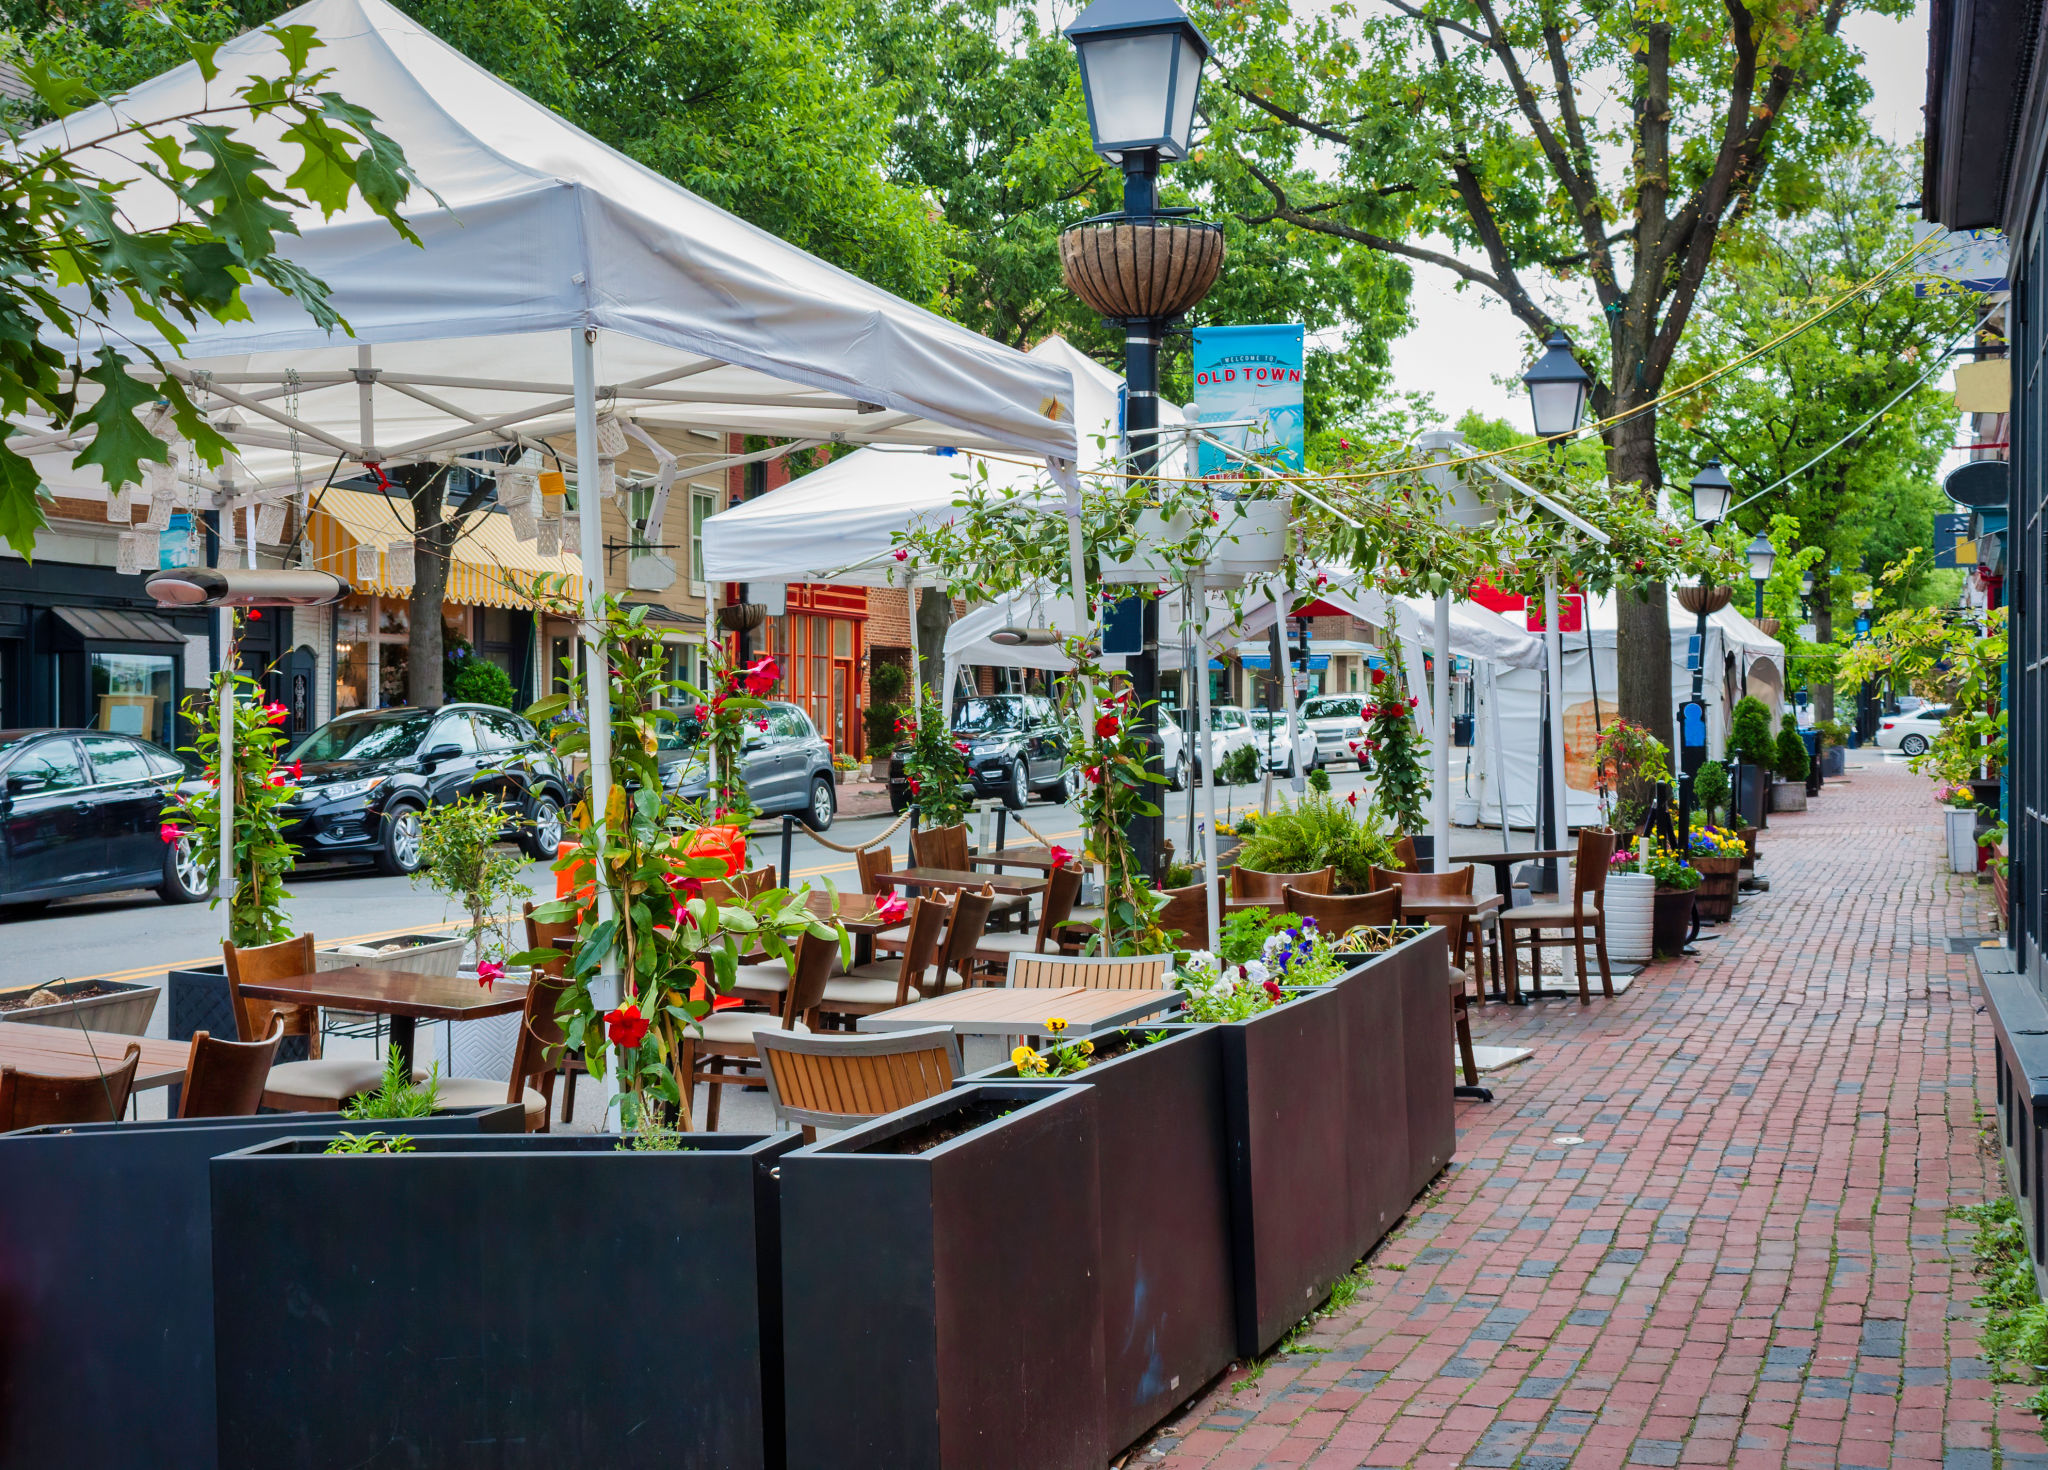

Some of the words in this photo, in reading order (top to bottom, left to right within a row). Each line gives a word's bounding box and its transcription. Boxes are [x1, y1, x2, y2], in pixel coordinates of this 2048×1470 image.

[1224, 355, 1260, 363] WELCOME
[1197, 369, 1236, 386] OLD
[1242, 367, 1301, 382] TOWN
